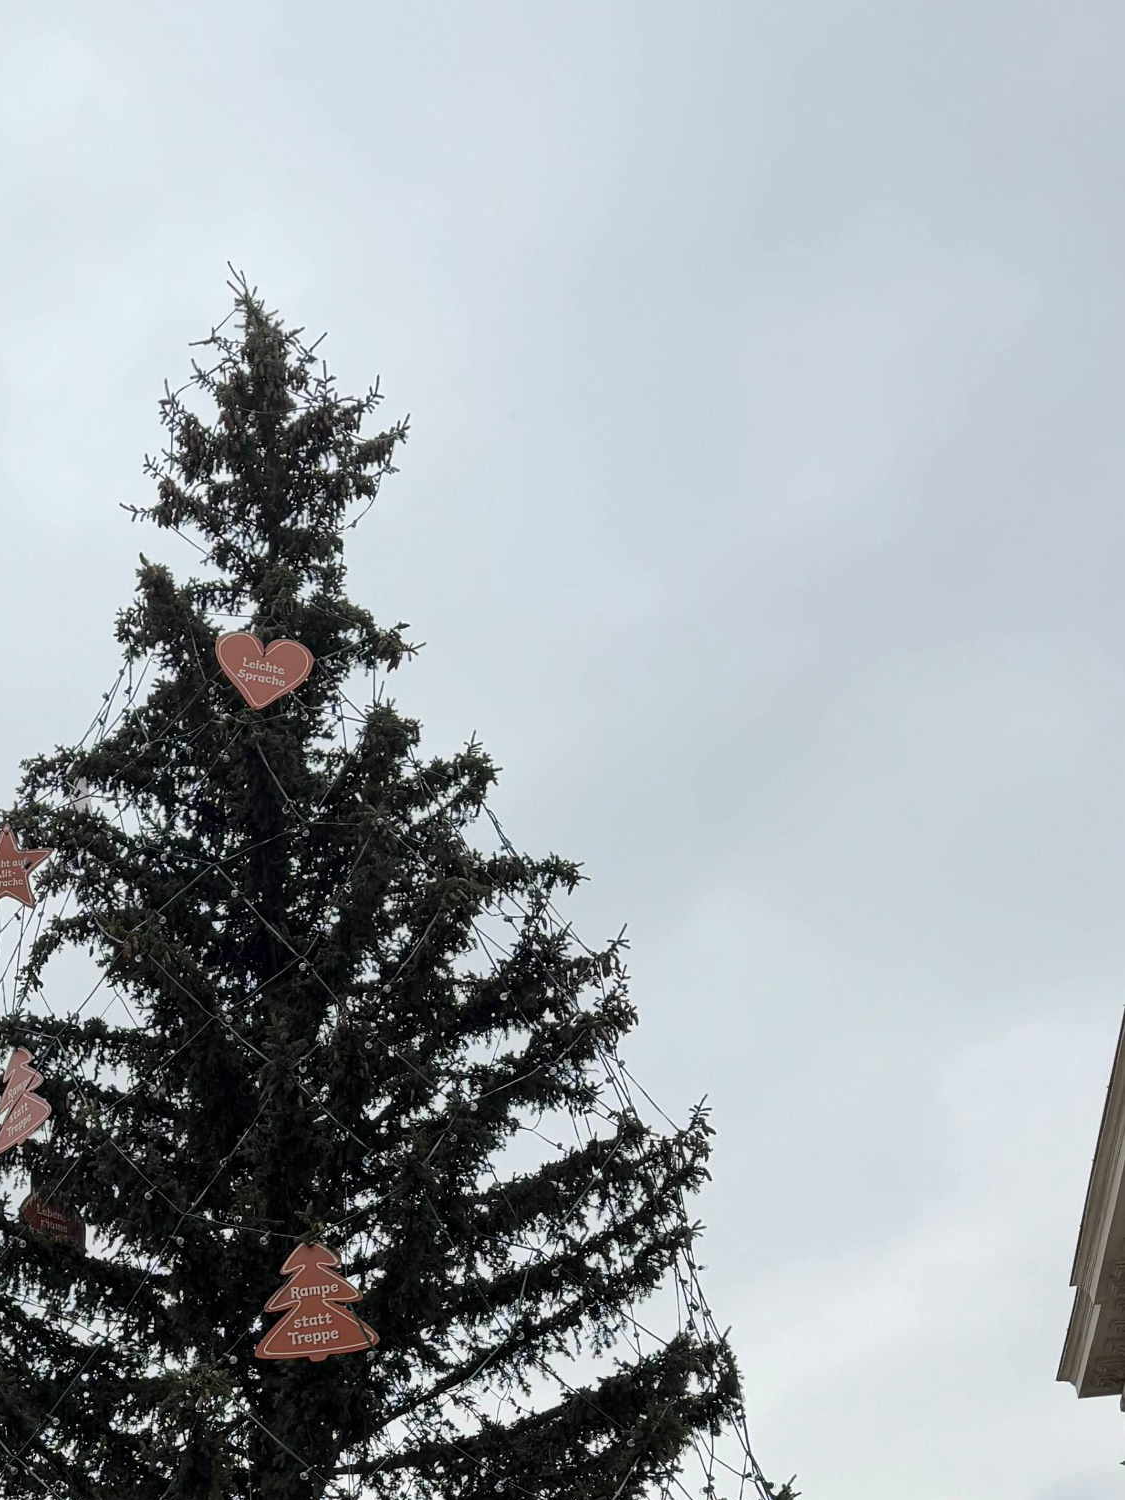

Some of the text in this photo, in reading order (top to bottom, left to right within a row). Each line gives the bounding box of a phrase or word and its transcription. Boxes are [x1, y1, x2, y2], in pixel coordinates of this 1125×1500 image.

[242, 656, 285, 675] Leichte
[236, 668, 286, 687] Sprache
[9, 1101, 29, 1123] statt
[6, 1113, 32, 1137] Treppe
[290, 1283, 339, 1299] Rampe
[293, 1312, 333, 1329] statt
[287, 1329, 339, 1345] Treppe
